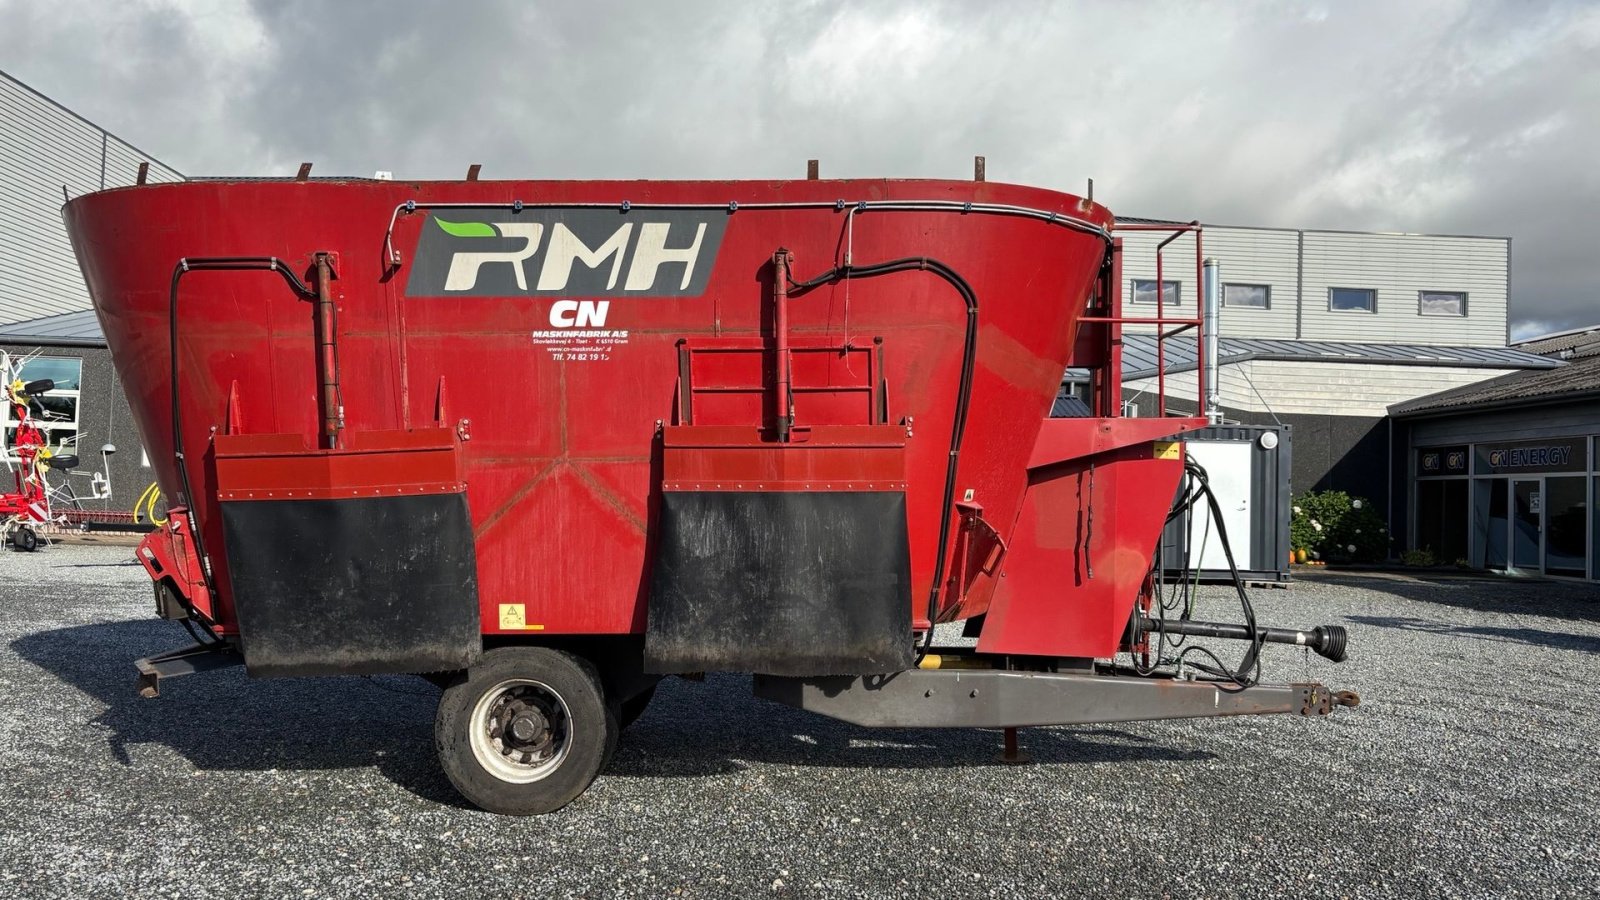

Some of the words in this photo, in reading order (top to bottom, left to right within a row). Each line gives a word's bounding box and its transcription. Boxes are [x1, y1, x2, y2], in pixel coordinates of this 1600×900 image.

[436, 217, 707, 291] RMH
[549, 300, 610, 328] CN
[532, 330, 610, 338] MASKINFABRIK
[611, 330, 629, 338] A/S
[1488, 449, 1508, 467] CN
[1509, 446, 1571, 467] ENERGY
